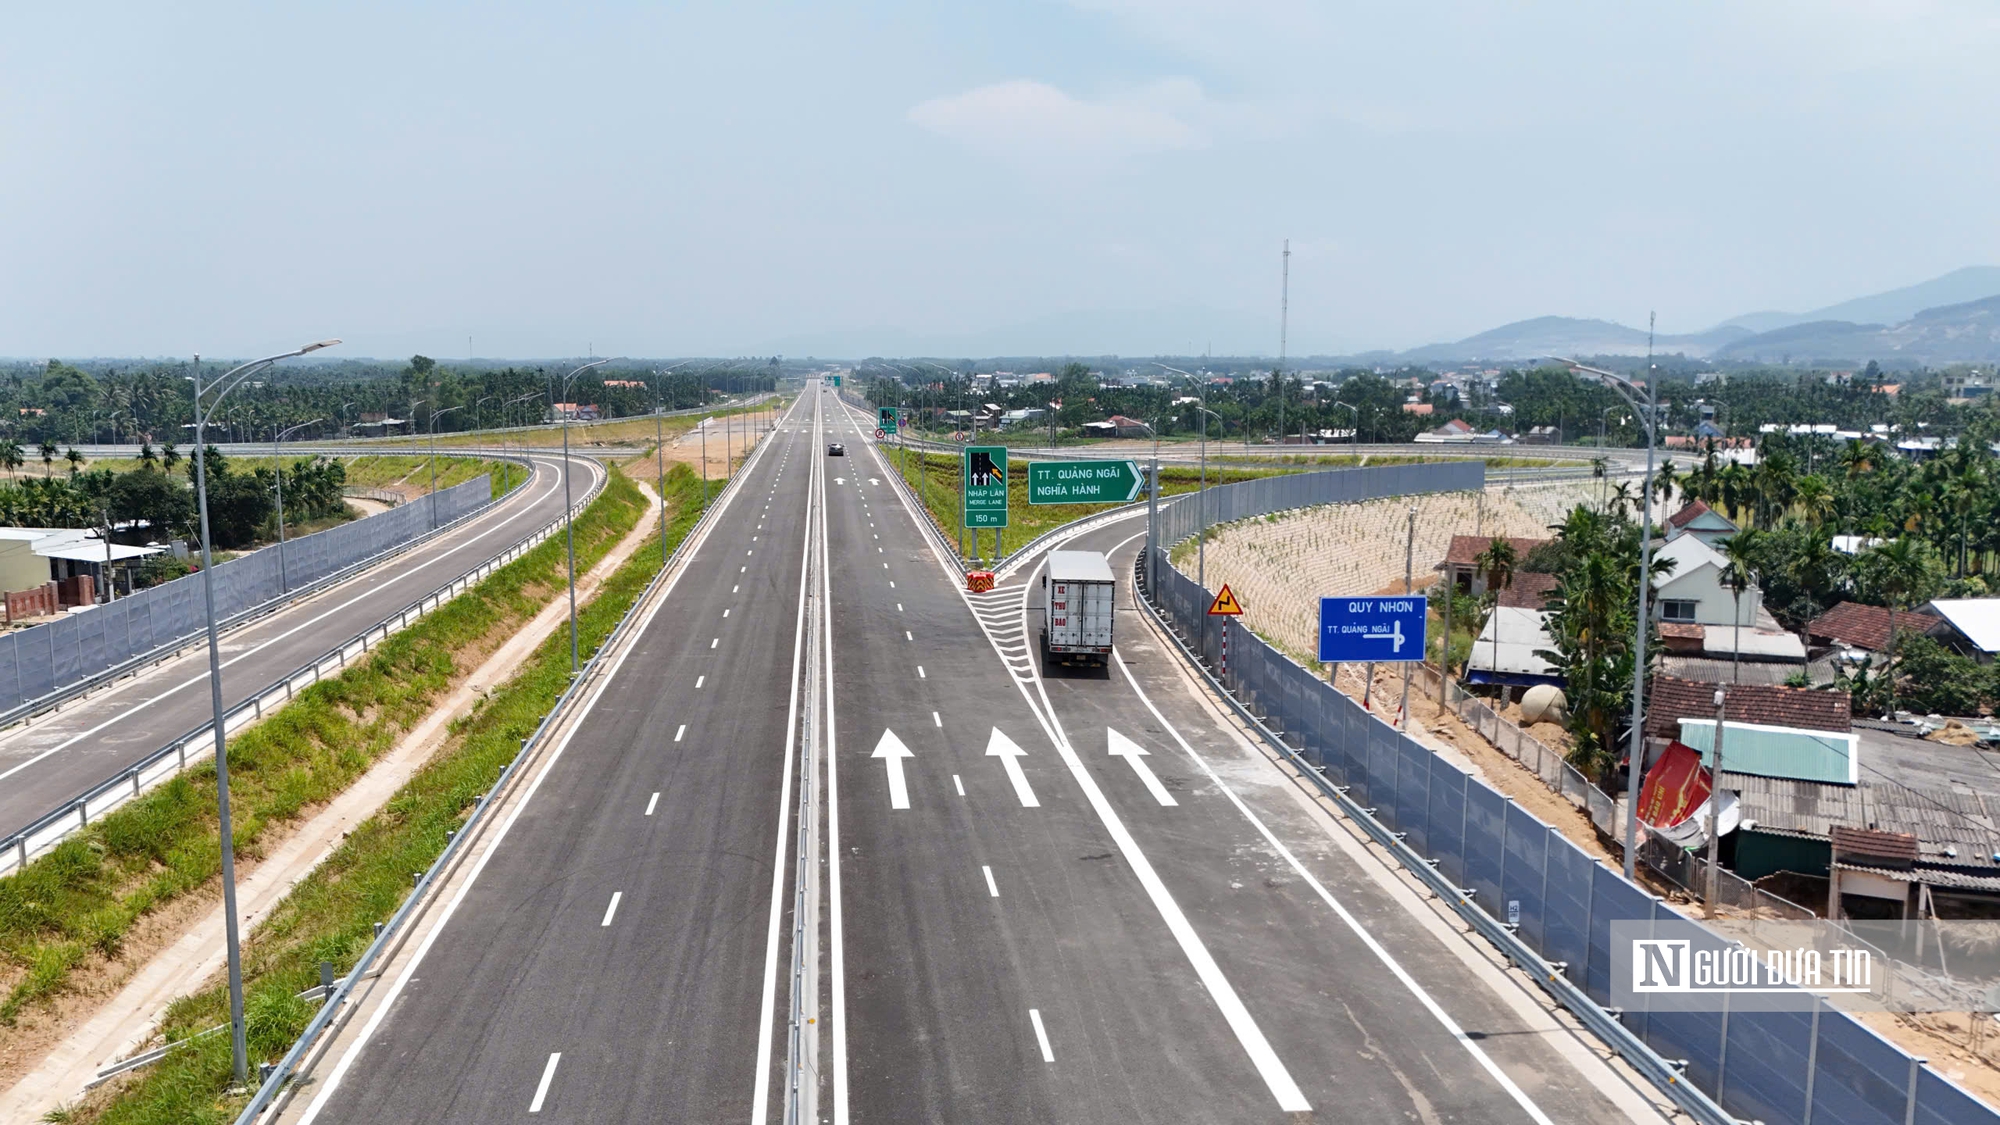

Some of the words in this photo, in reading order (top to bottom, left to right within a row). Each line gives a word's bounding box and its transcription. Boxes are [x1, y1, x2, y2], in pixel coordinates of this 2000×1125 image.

[1037, 470, 1054, 480] TT.
[1058, 466, 1093, 479] QUẢNG
[1096, 466, 1120, 478] NGÃI
[989, 489, 1005, 497] LÀN
[1037, 483, 1068, 496] NGHĨA
[1072, 483, 1101, 495] HÀNH
[975, 514, 988, 523] 150
[1058, 586, 1065, 594] XE
[1349, 602, 1373, 613] QUY
[1379, 601, 1413, 613] NHƠN
[1327, 625, 1340, 634] TT.
[1341, 622, 1368, 633] QUẢNG
[1371, 623, 1390, 633] NGÃI
